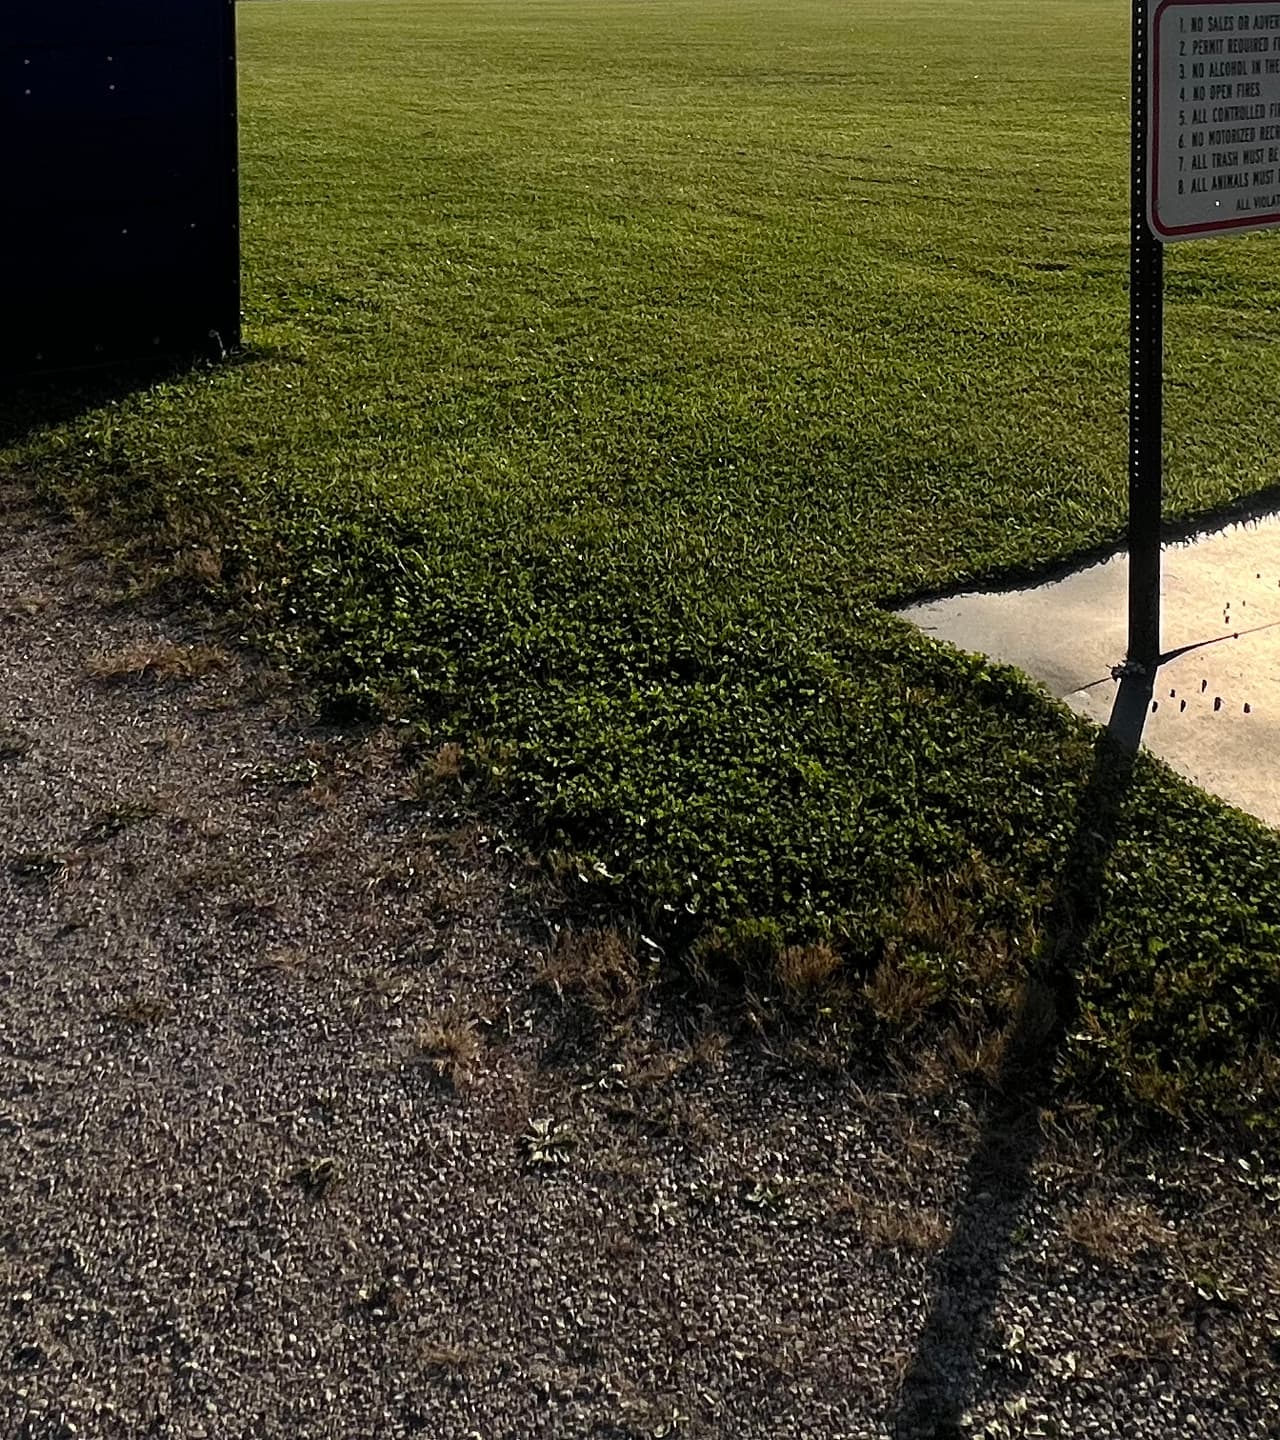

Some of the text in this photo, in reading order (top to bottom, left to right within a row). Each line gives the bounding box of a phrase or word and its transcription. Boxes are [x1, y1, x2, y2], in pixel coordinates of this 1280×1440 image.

[1191, 17, 1203, 32] NO
[1208, 16, 1234, 31] SALES
[1238, 15, 1250, 30] OR
[1192, 39, 1224, 55] PERMIT
[1228, 37, 1268, 53] REQUIRED
[1192, 62, 1205, 79] NO
[1209, 60, 1248, 78] ALCOHOL
[1252, 59, 1262, 75] IN
[1265, 58, 1280, 74] THE
[1193, 86, 1205, 101] NO
[1209, 84, 1233, 99] OPEN
[1192, 109, 1208, 124] ALL
[1213, 104, 1265, 122] CONTROLLED
[1192, 131, 1204, 147] NO
[1209, 127, 1256, 145] MOTORIZED
[1191, 154, 1208, 170] ALL
[1212, 151, 1239, 168] TRASH
[1243, 149, 1264, 165] MUST
[1268, 147, 1278, 162] BE
[1191, 177, 1208, 193] ALL
[1211, 172, 1248, 190] ANIMALS
[1253, 169, 1274, 185] MUST
[1236, 198, 1251, 211] ALL
